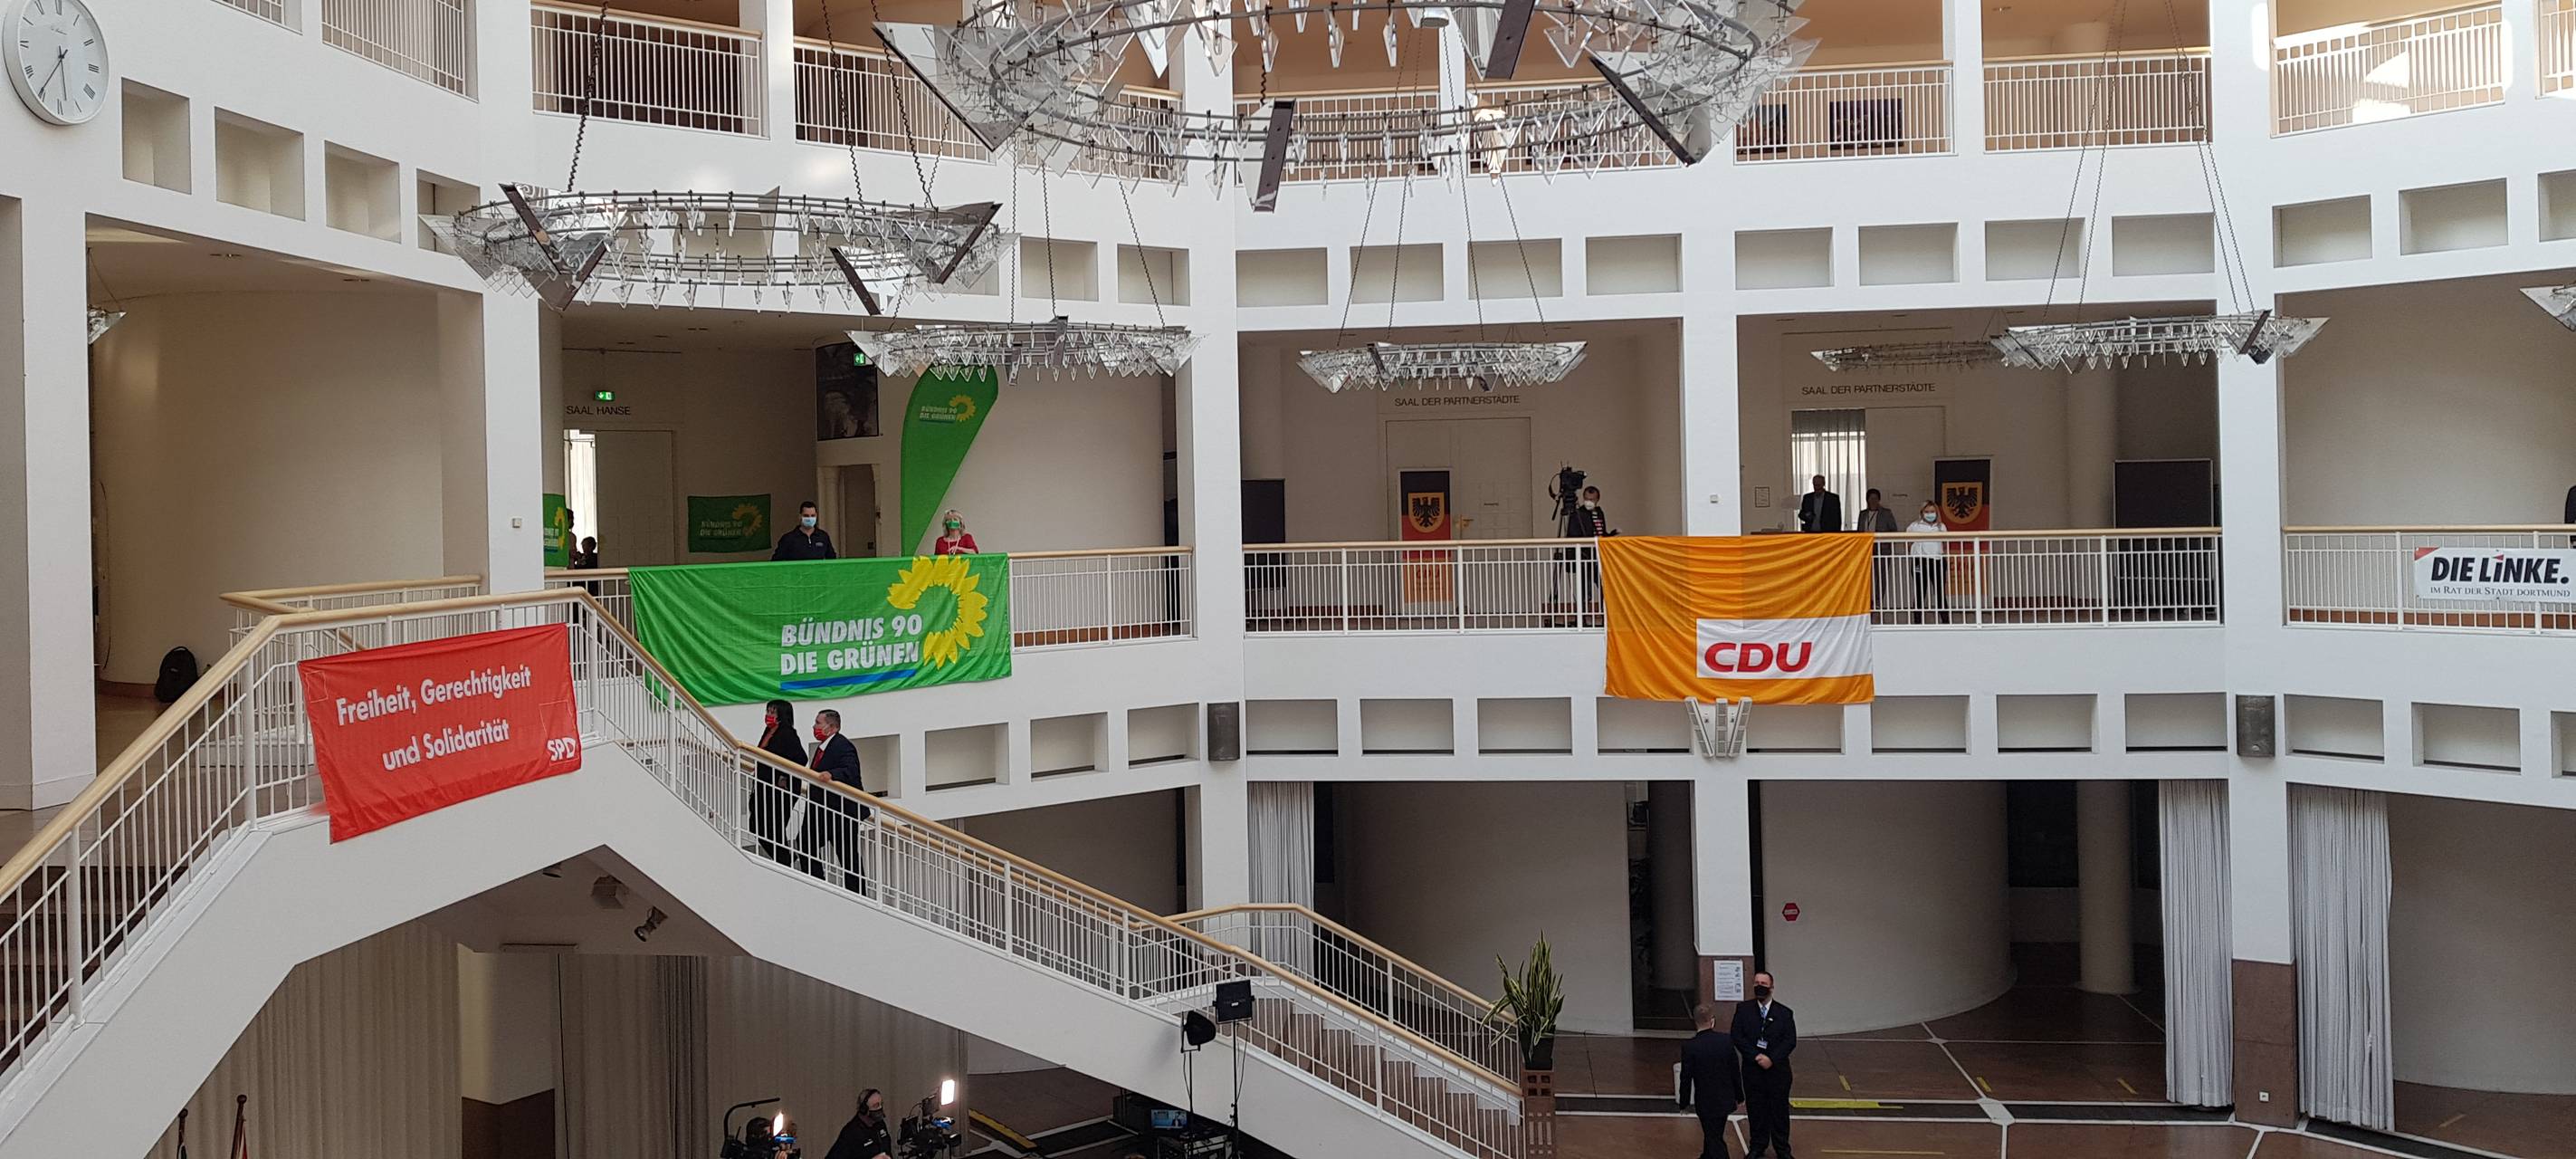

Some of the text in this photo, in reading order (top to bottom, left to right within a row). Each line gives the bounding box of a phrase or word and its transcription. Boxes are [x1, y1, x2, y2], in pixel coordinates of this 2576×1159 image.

[1395, 394, 1521, 407] SAAL DER PARTNERSTÄDTE
[1801, 381, 1936, 395] SAAL DER PARTNERSTÄDTE
[566, 406, 632, 415] SAAL HANSE
[2431, 557, 2475, 582] DIE
[781, 614, 922, 647] BÜNDNIS 90
[780, 640, 921, 675] DIE GRÜNEN
[1703, 642, 1812, 673] CDU
[335, 665, 531, 725] Freiheit, Gerechtigkeit
[382, 718, 510, 771] und Solidarität
[547, 736, 577, 761] SPD
